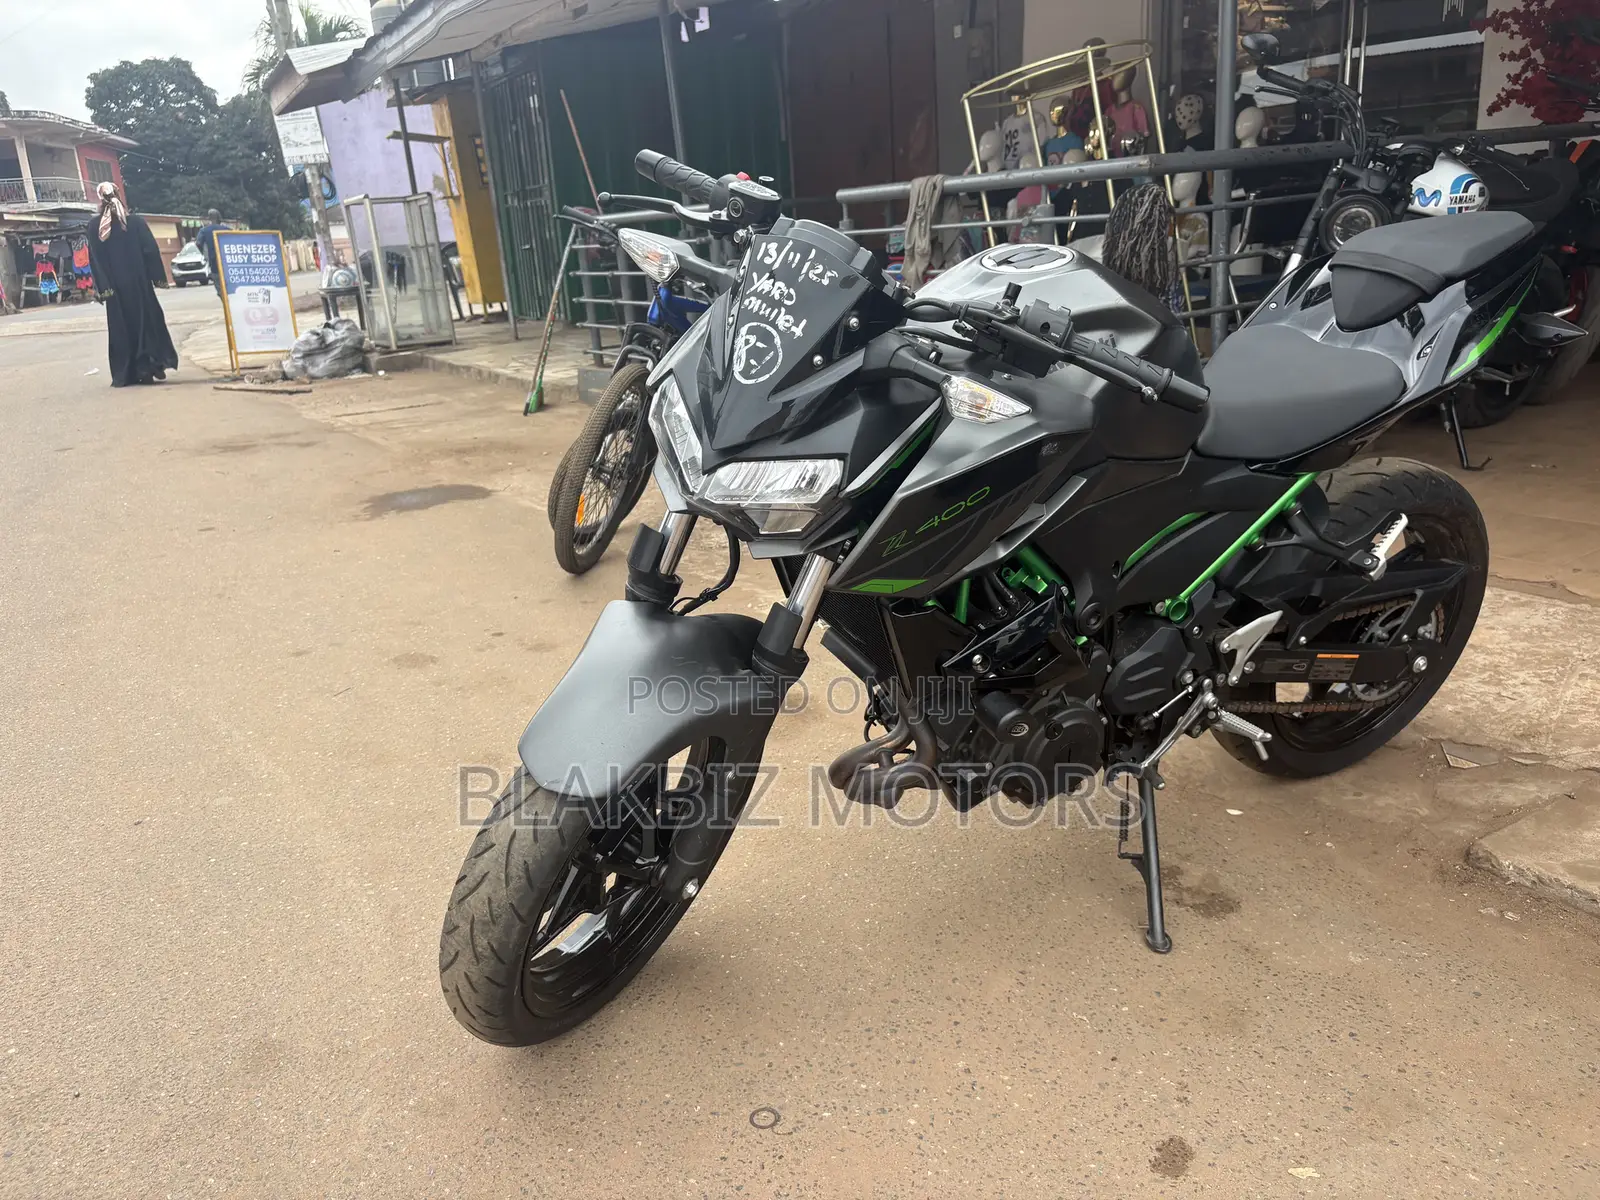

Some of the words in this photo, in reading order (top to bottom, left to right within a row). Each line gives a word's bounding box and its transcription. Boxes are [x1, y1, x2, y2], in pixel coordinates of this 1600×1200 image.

[1449, 194, 1476, 206] YAMAHA
[223, 243, 277, 254] EBENEZER
[225, 254, 249, 263] BUSY
[251, 254, 277, 263] SHOP
[915, 486, 991, 535] 400
